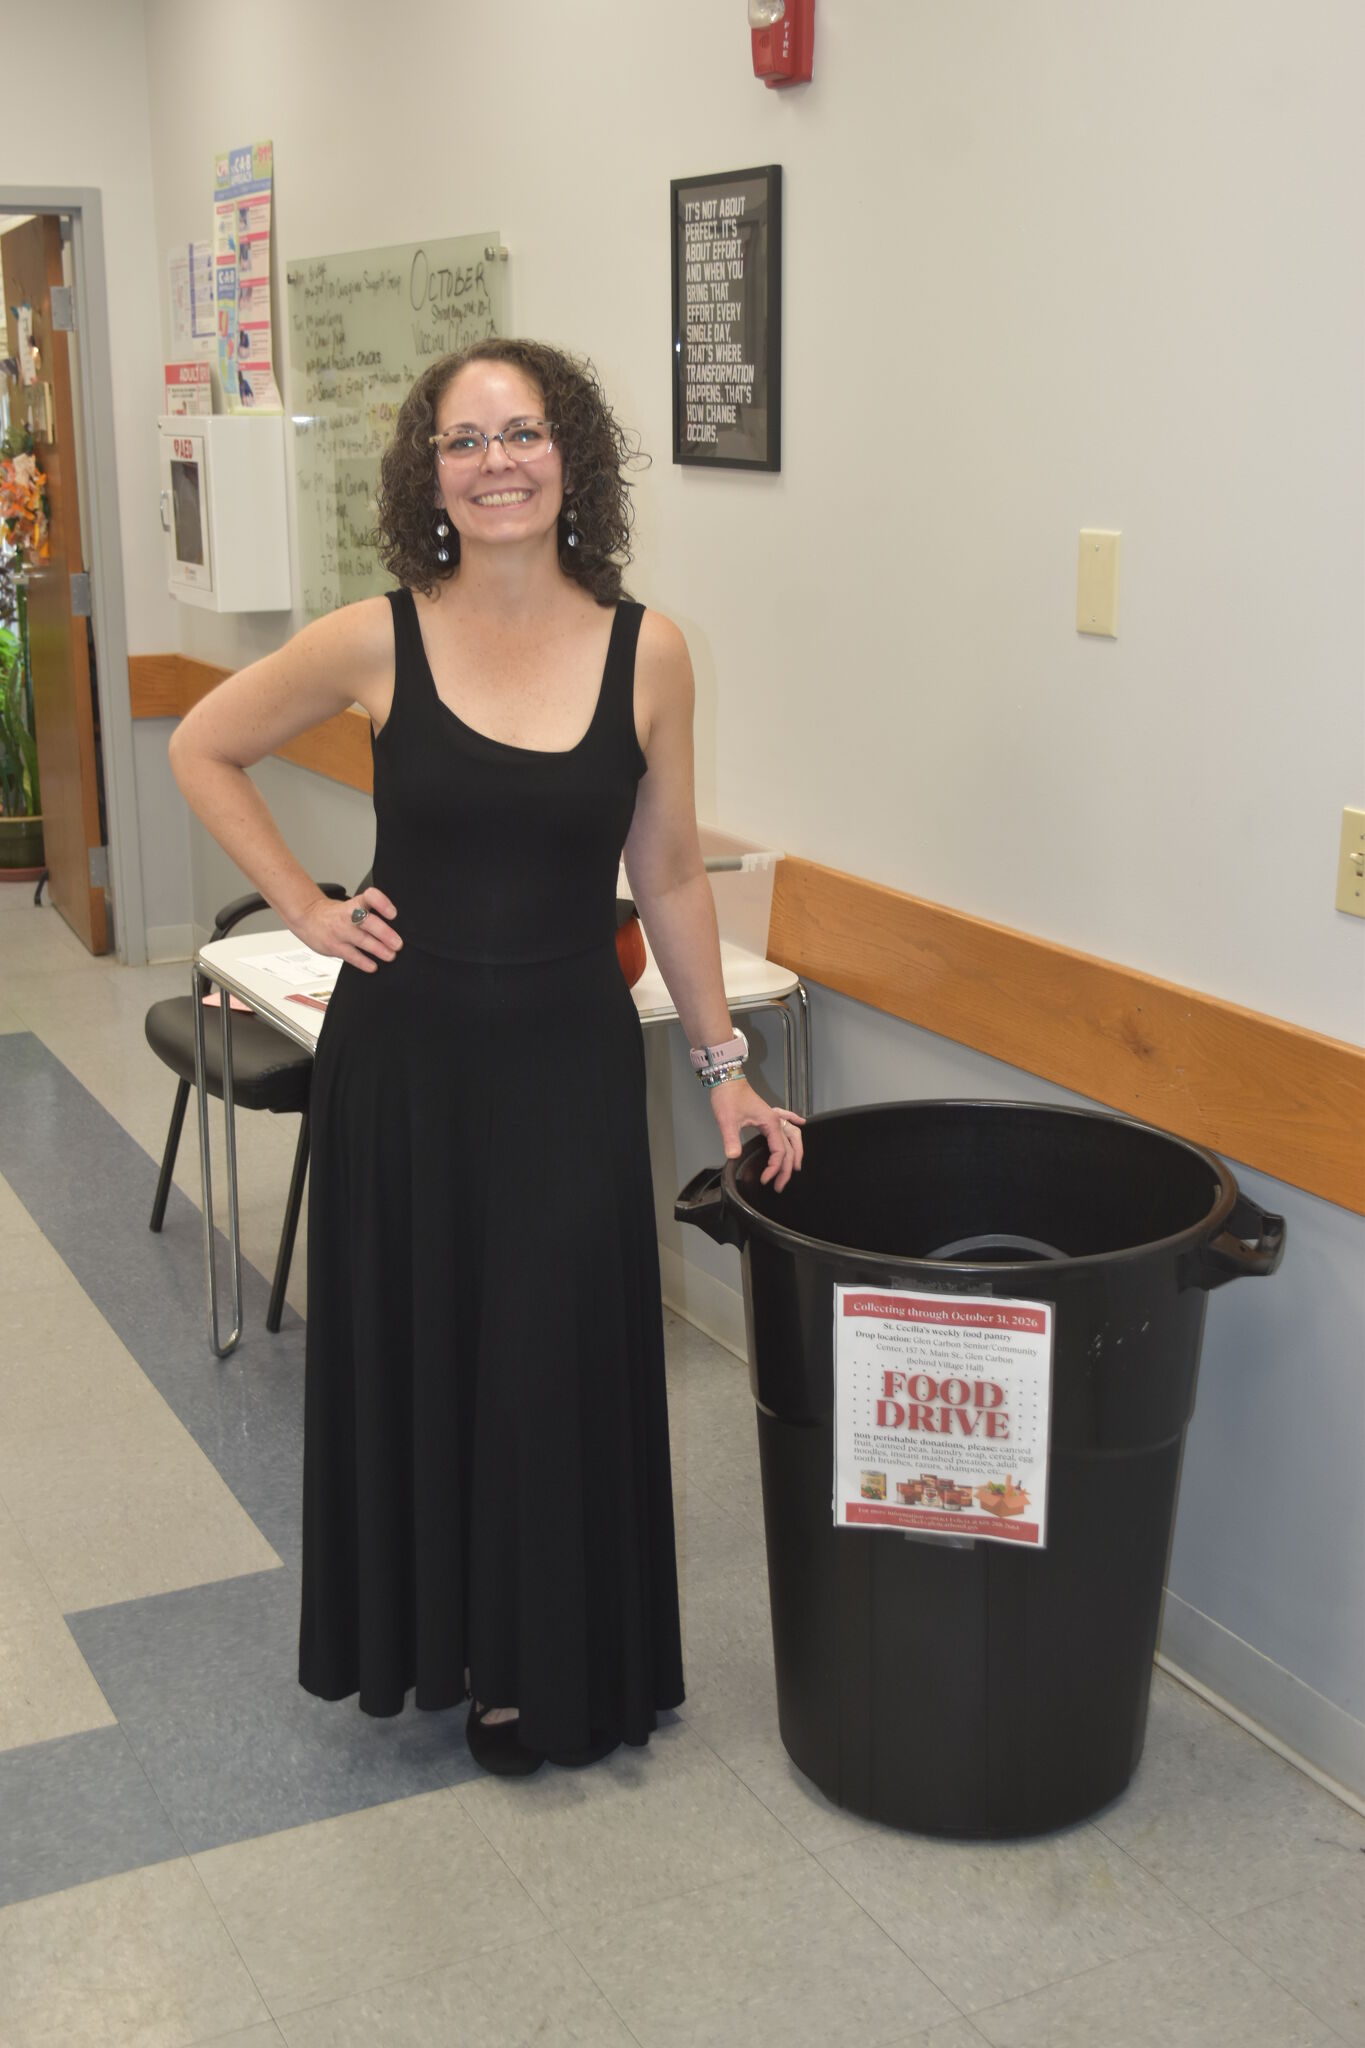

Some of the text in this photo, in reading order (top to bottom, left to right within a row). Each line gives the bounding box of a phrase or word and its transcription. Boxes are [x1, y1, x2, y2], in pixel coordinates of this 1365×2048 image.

[686, 196, 746, 221] IT'S NOT ABOUT
[686, 219, 737, 242] PERFECT. IT'S
[686, 240, 744, 262] ABOUT EFFORT.
[410, 248, 489, 311] OCTOBER
[686, 260, 744, 282] AND WHEN YOU
[686, 282, 729, 303] BRING THAT
[687, 302, 741, 322] EFFORT EVERY
[687, 324, 712, 343] SINGLE
[686, 343, 742, 363] THAT'S WHERE
[686, 364, 755, 383] TRANSFORMATION
[686, 384, 752, 404] HAPPENS. THAT'S
[686, 404, 737, 424] HOW CHANGE
[686, 424, 719, 443] OCCURS.
[180, 439, 193, 459] AED
[853, 1302, 906, 1319] Collecting
[907, 1307, 949, 1321] through
[951, 1310, 994, 1323] October
[1012, 1316, 1038, 1328] 2026
[883, 1322, 1012, 1343] St. Cecilia's weekly food pantry
[855, 1330, 1038, 1358] Drop location: Glen Carbon Senior/Community
[906, 1357, 984, 1374] (behind Village Hall)
[929, 1348, 949, 1358] Main
[965, 1352, 984, 1361] Glen
[985, 1353, 1014, 1365] Carbon
[884, 1370, 1004, 1409] FOOD
[876, 1399, 1010, 1440] DRIVE
[873, 1434, 918, 1446] perishable
[1000, 1446, 1031, 1456] canned
[875, 1443, 906, 1453] canned
[931, 1447, 963, 1459] laundry
[854, 1454, 874, 1464] tooth
[890, 1450, 919, 1460] instant
[921, 1453, 954, 1464] mashed
[995, 1459, 1018, 1469] adult
